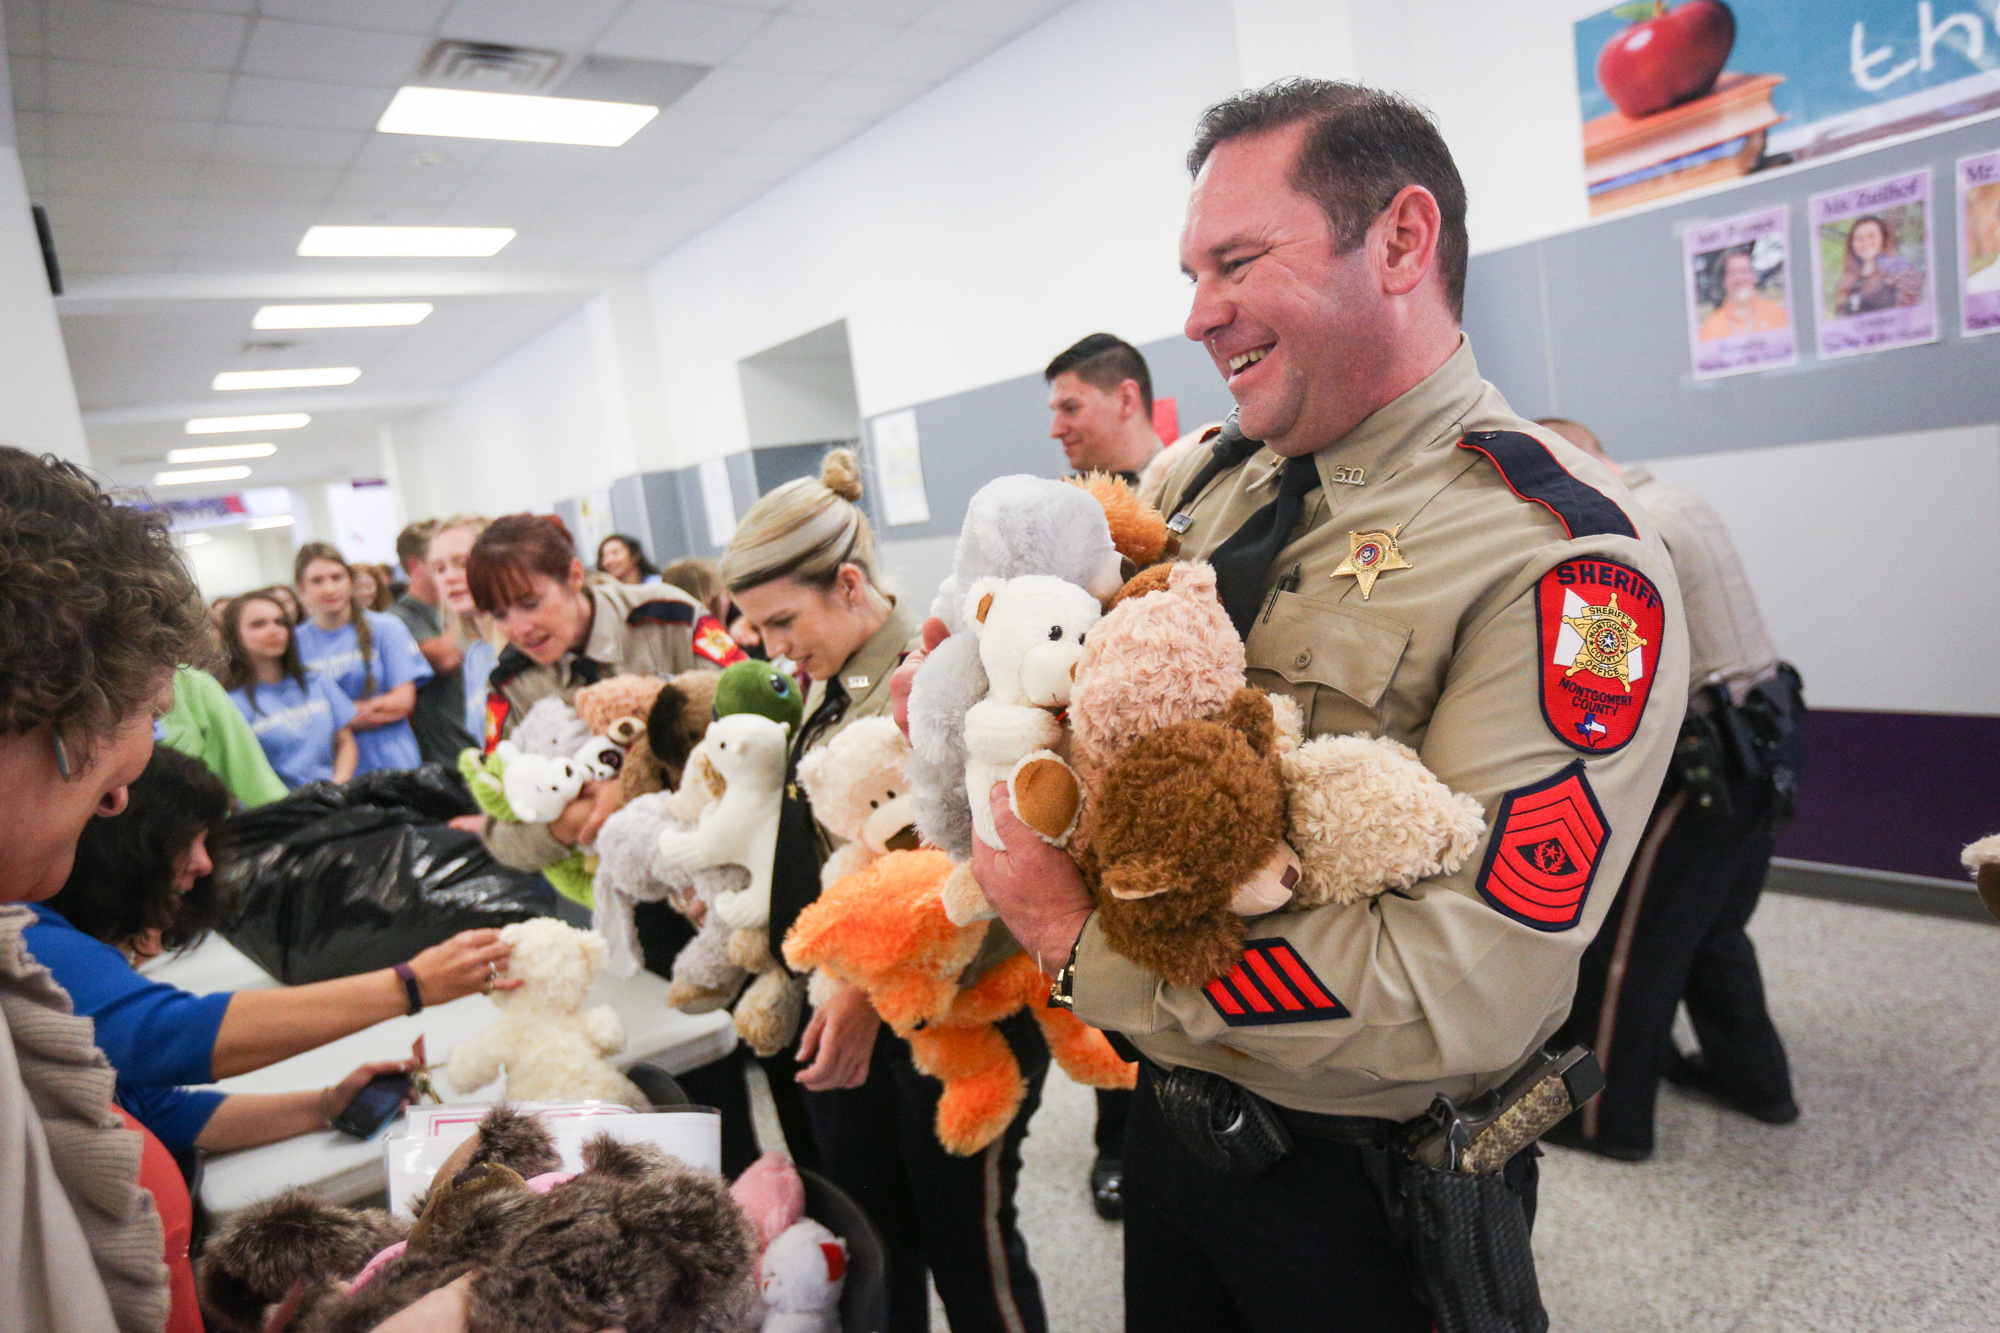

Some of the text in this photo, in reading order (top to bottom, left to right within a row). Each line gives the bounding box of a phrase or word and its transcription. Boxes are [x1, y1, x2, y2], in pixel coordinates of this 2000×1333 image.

[1850, 0, 2000, 92] th
[1556, 564, 1660, 609] SHERIFF
[1588, 606, 1633, 627] SHERIFF'S
[1589, 621, 1627, 647] MONTGOMERY
[1590, 647, 1621, 662] COUNTY
[1585, 659, 1620, 677] OFFICE
[1558, 677, 1633, 707] MONTGOMERY
[1571, 695, 1619, 716] COUNTY
